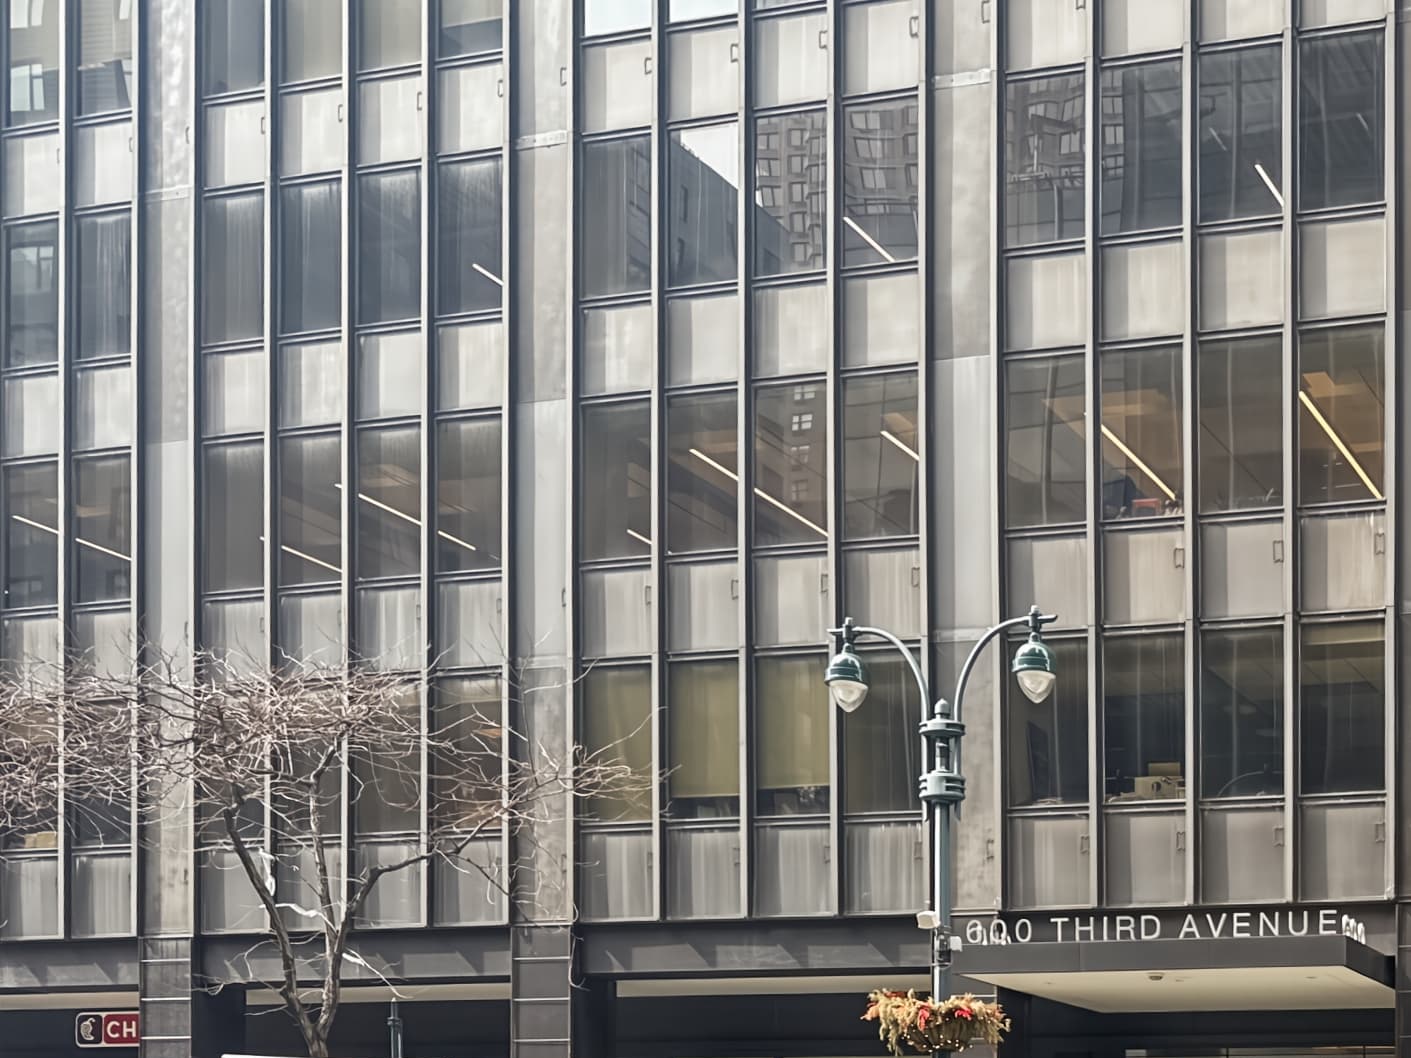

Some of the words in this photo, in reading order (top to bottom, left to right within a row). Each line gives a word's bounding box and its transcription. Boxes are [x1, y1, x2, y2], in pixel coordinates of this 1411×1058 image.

[966, 918, 1032, 944] 600
[1050, 914, 1161, 942] THIRD
[1179, 909, 1338, 940] AVENUE
